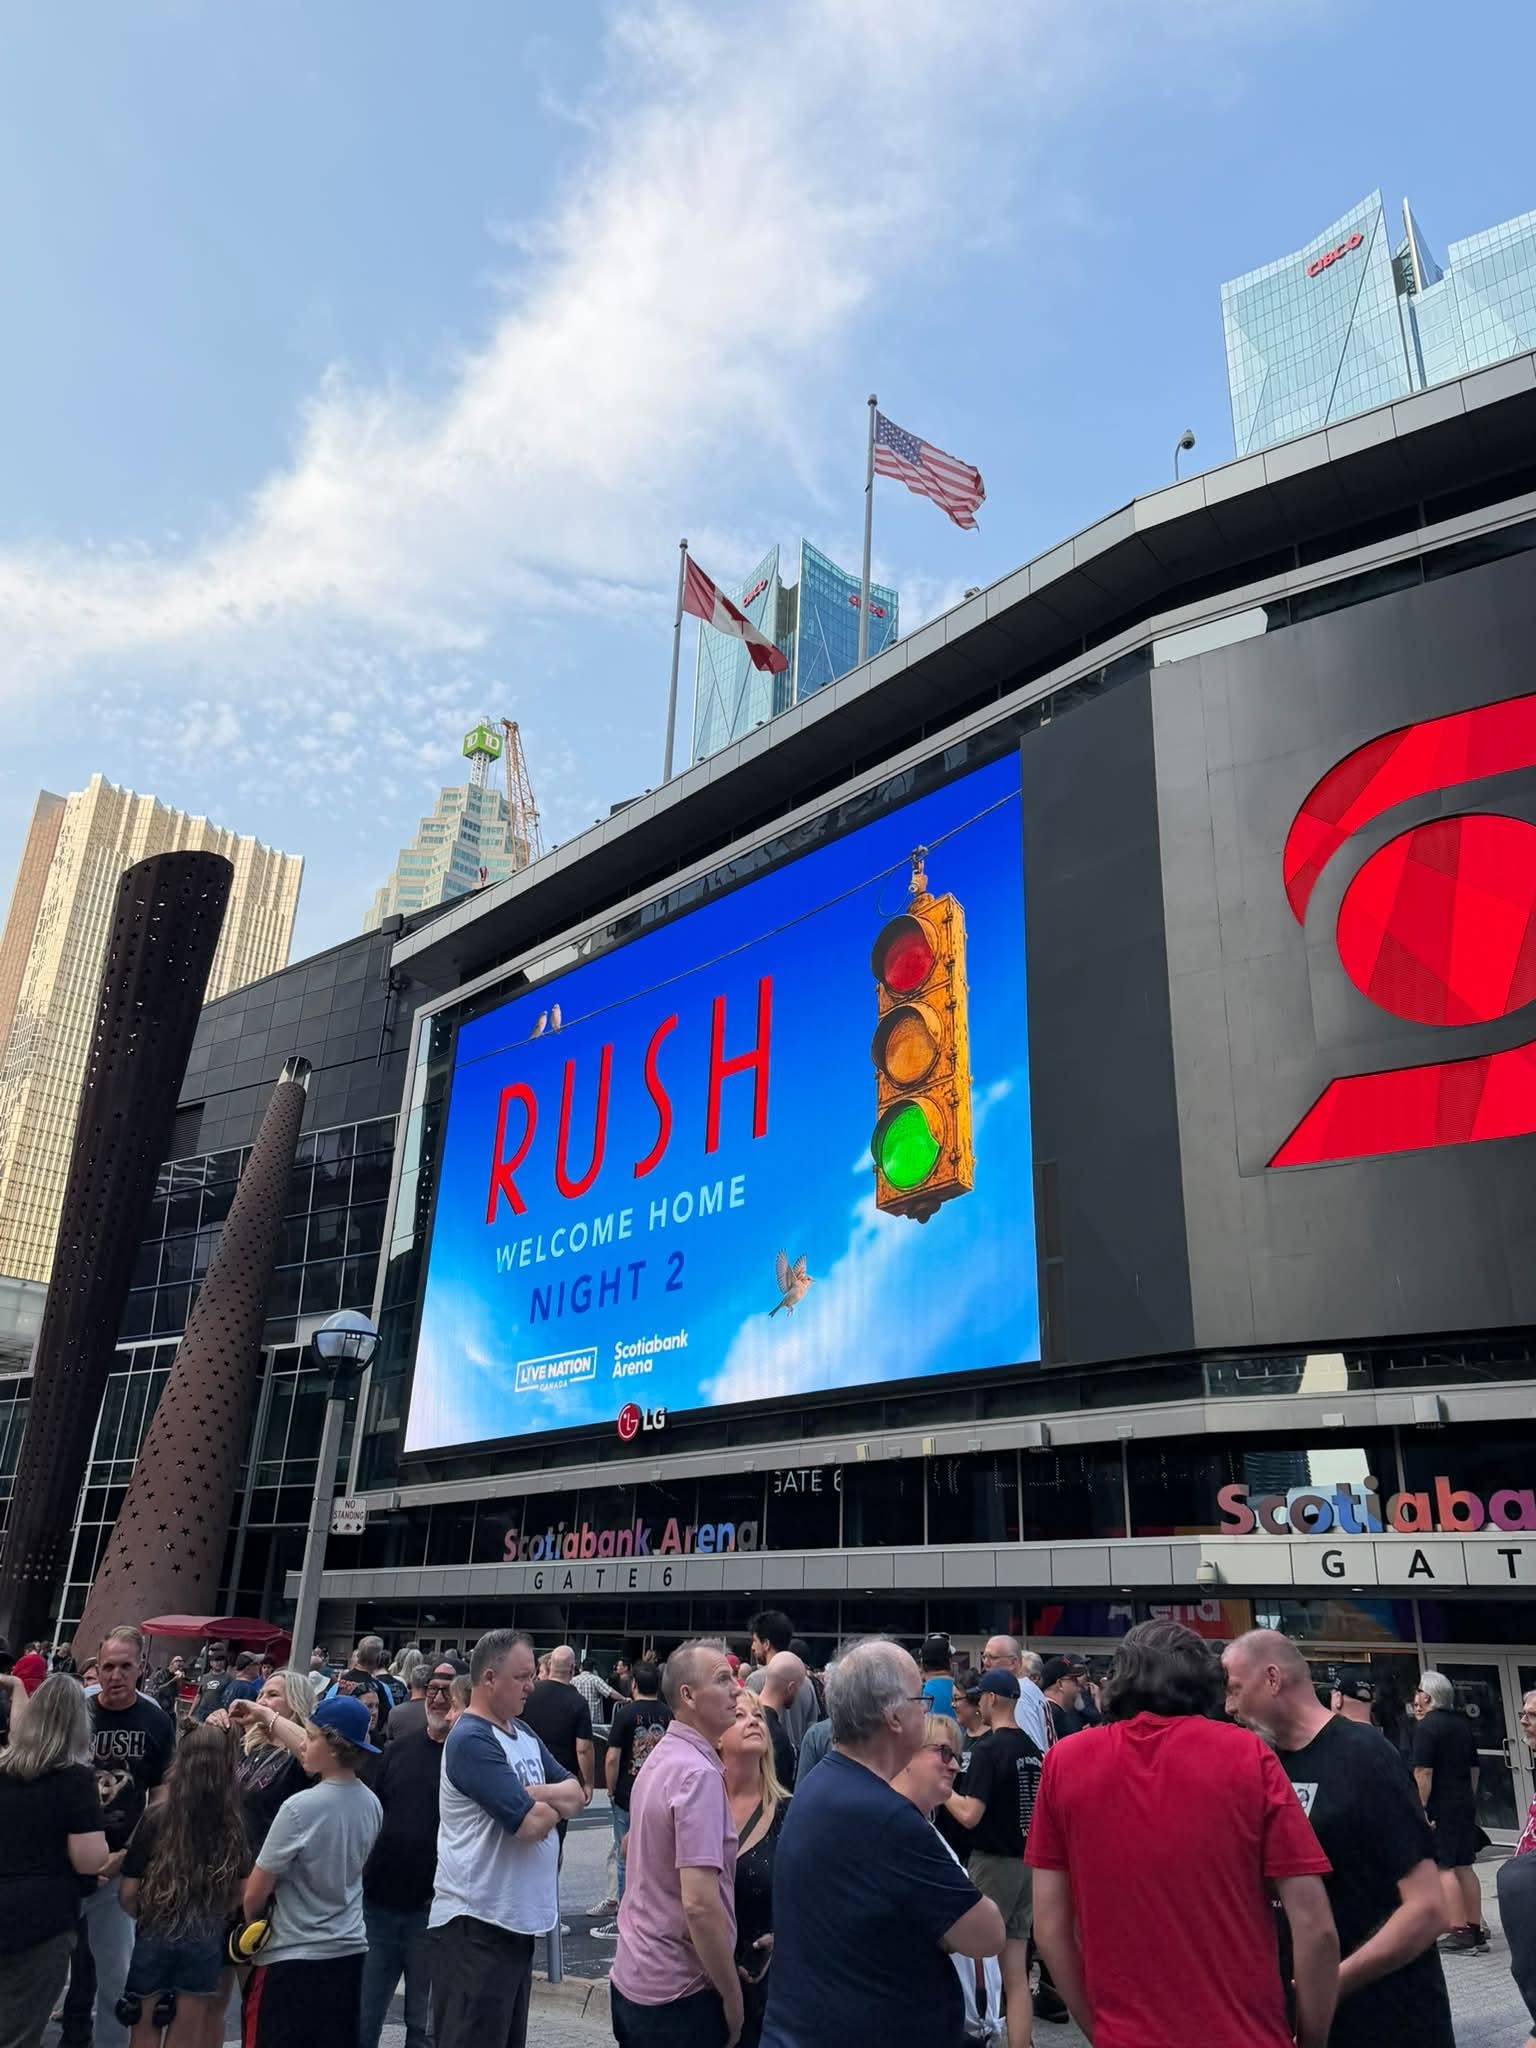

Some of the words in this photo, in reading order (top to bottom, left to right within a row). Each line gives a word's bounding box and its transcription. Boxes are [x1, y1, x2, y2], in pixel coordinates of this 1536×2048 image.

[485, 975, 773, 1225] RUSH
[496, 1208, 633, 1273] WELCOME
[649, 1174, 746, 1232] HOME
[529, 1260, 646, 1324] NIGHT
[665, 1251, 685, 1292] 2
[613, 1329, 688, 1360] Scotiabank
[520, 1364, 549, 1384] LIVE
[548, 1357, 591, 1377] NATION
[612, 1358, 653, 1379] Arena
[643, 1407, 667, 1431] LG
[333, 1510, 364, 1521] STANDING
[344, 1500, 356, 1509] NO
[502, 1518, 652, 1563] Scotiabank
[660, 1517, 759, 1556] Arena
[533, 1568, 638, 1590] GATE
[662, 1566, 673, 1587] 6
